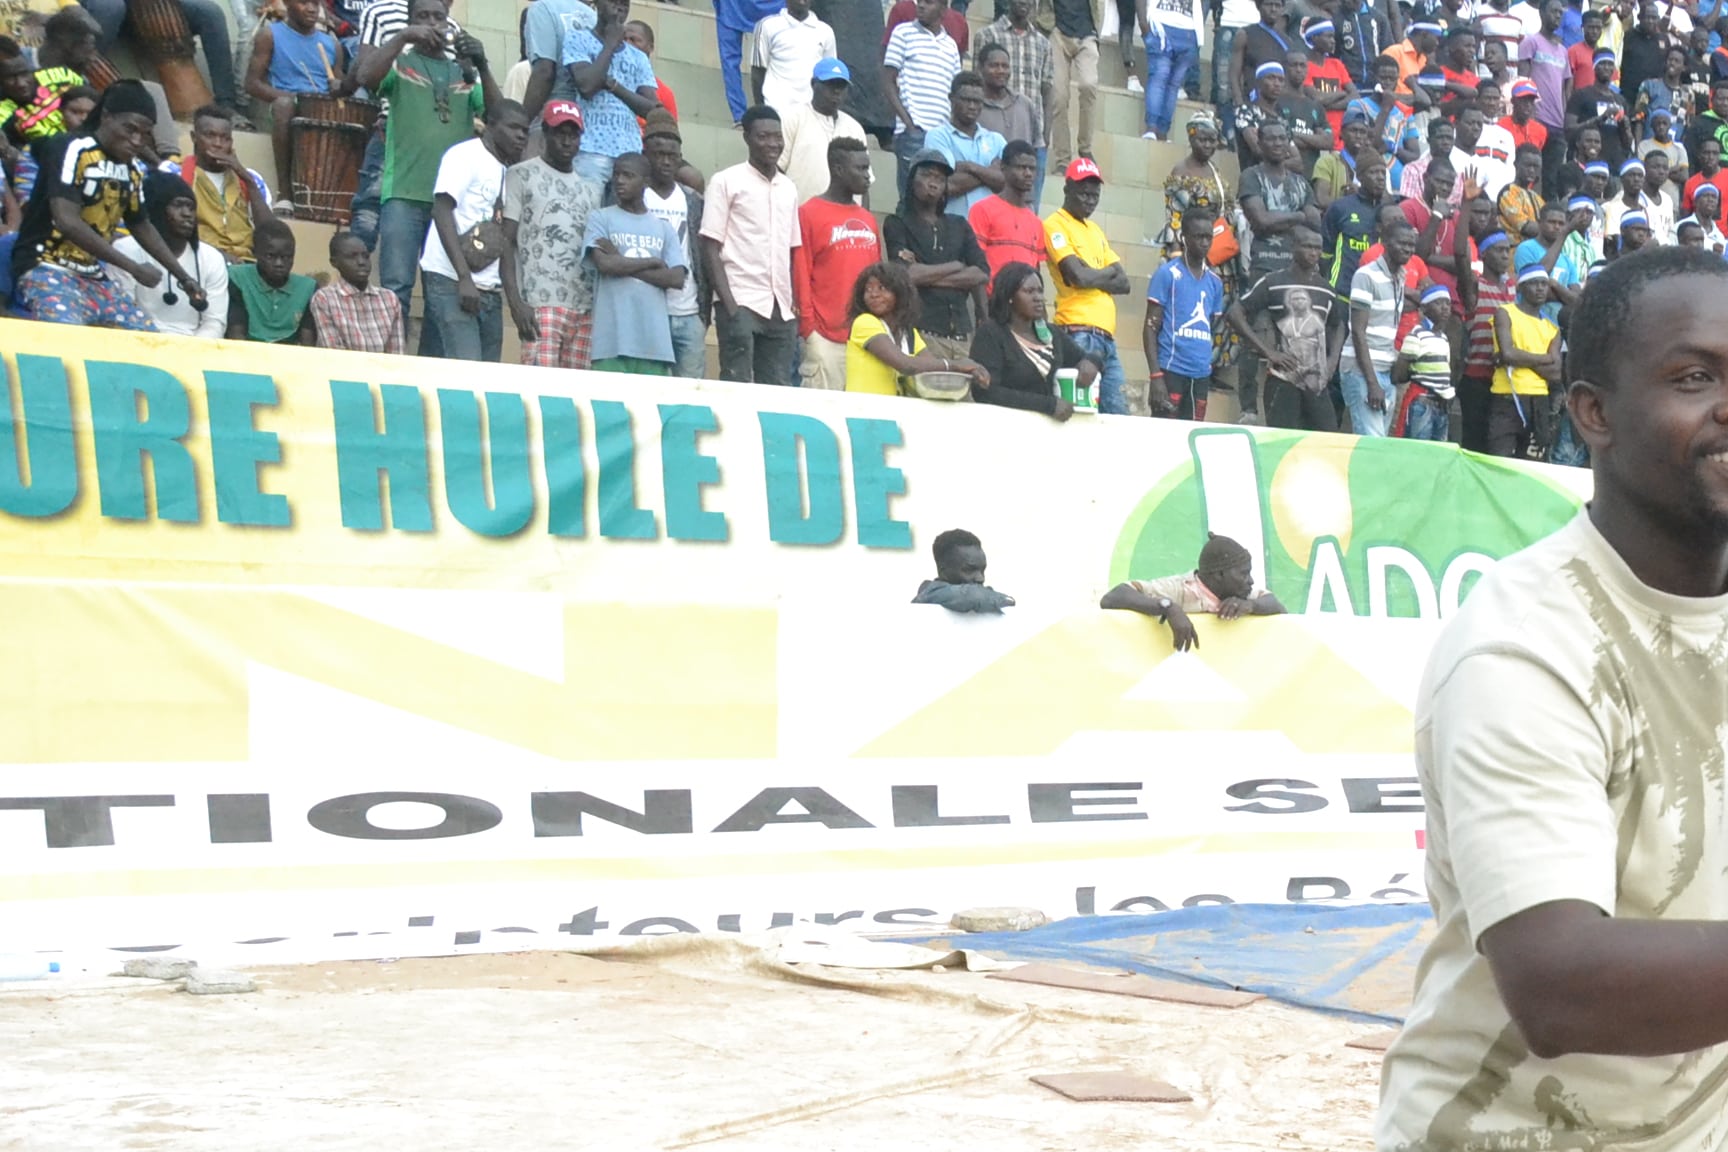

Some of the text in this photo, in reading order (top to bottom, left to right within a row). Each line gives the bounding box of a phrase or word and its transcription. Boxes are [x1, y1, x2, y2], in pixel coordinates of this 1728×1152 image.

[552, 103, 580, 118] FILA
[0, 353, 911, 547] URE HUILE DE
